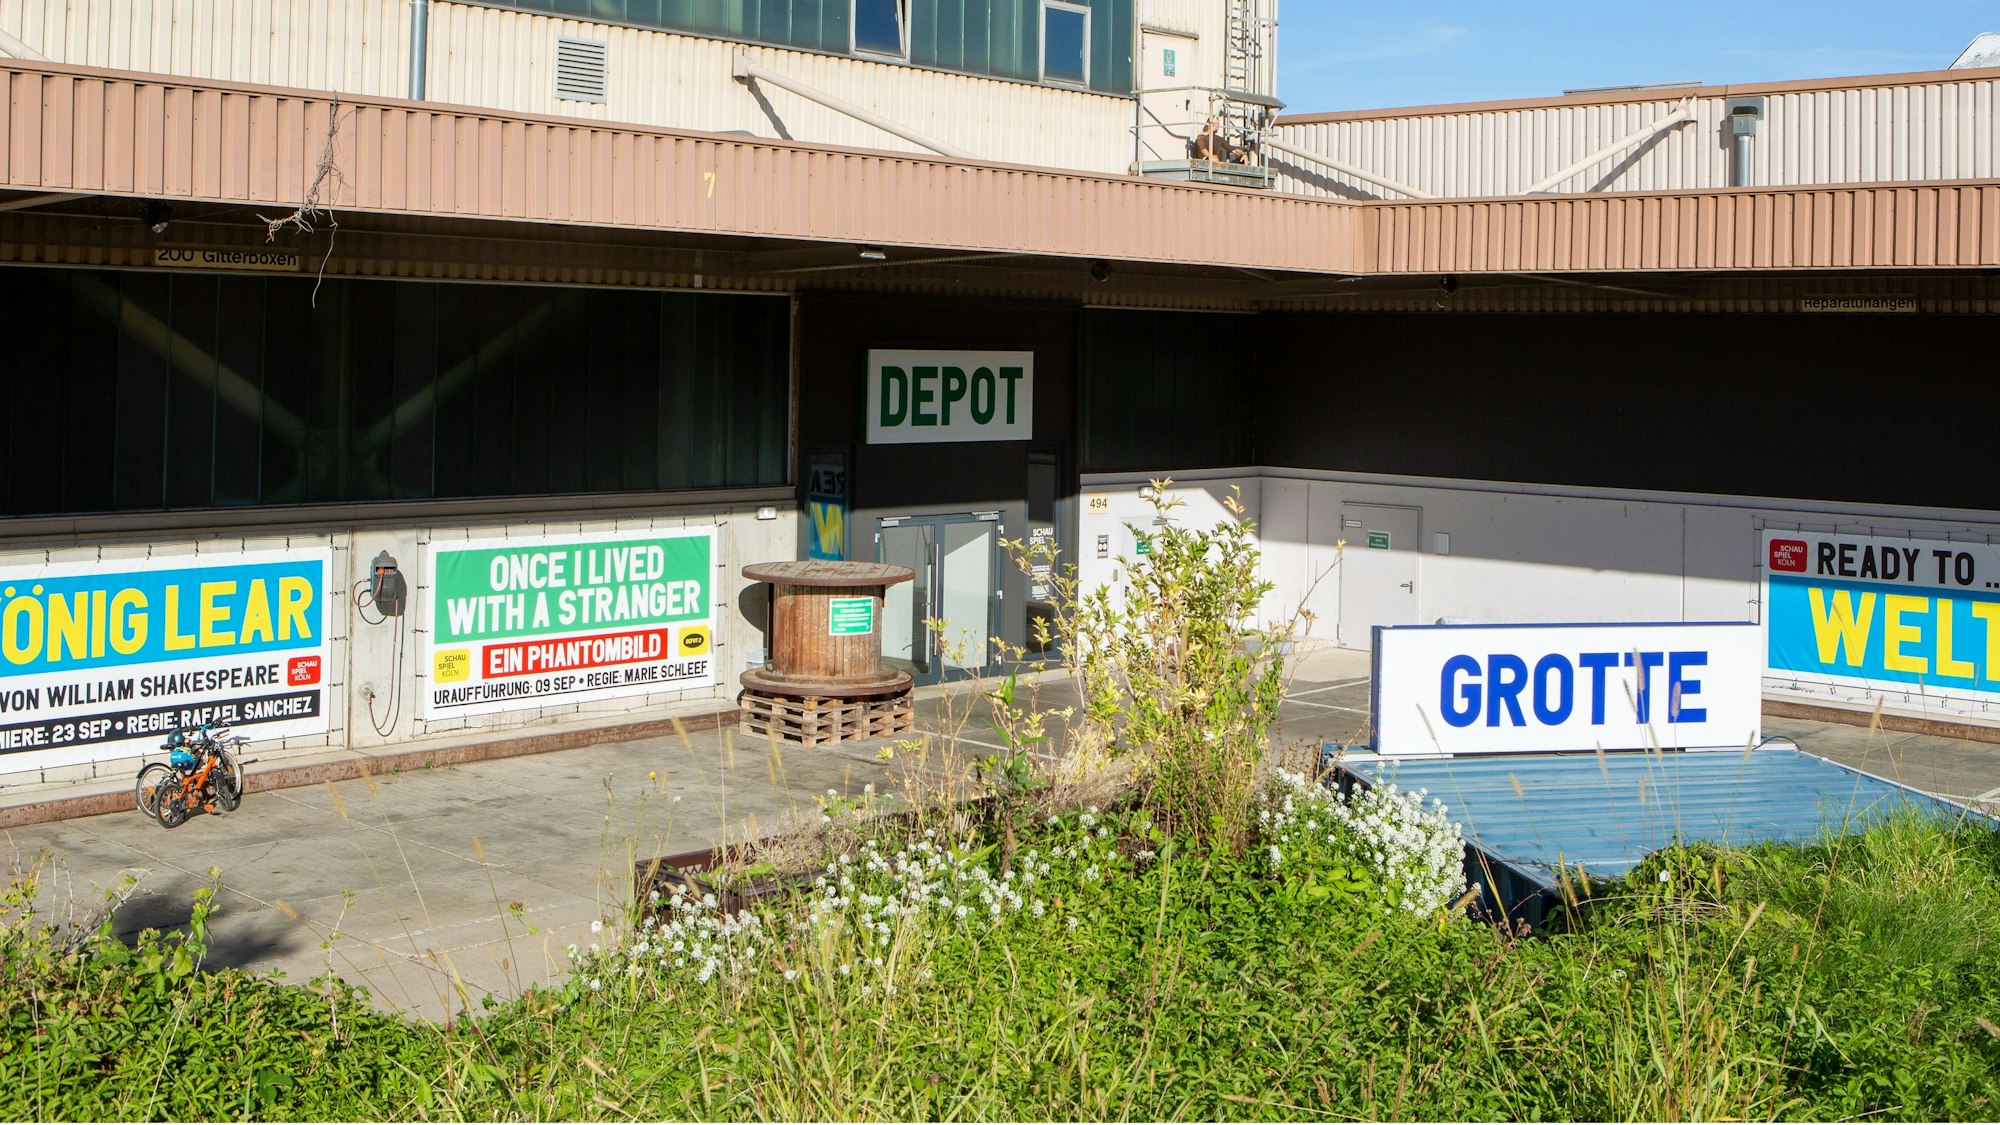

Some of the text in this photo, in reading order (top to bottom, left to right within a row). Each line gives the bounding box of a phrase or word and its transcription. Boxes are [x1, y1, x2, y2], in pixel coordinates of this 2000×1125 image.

[704, 172, 715, 198] 7
[158, 249, 297, 266] 200 Gitterboxen
[880, 366, 1023, 427] DEPOT
[1090, 498, 1107, 509] 494
[1029, 536, 1045, 545] SPIEL
[1033, 527, 1054, 537] SCHAU
[1774, 551, 1792, 559] SPIEL
[1780, 545, 1803, 553] SCHAU
[490, 545, 664, 591] ONCE I LIVED
[1777, 558, 1796, 567] KÖLN
[1817, 541, 1920, 582] READY
[1932, 550, 1975, 586] TO
[447, 579, 701, 636] WITH A STRANGER
[0, 576, 313, 665] ÖNIG LEAR
[1807, 587, 2000, 682] WELT
[444, 654, 466, 662] SCHAU
[490, 633, 661, 675] EIN PHANTOMBILD
[291, 667, 307, 675] SPIEL
[438, 662, 455, 670] SPIEL
[442, 669, 459, 677] KÖLN
[294, 673, 311, 681] KÖLN
[434, 660, 708, 705] URAUFFÜHRUNG: 09 SEP REGIE: MARIE SCHLEEF
[0, 664, 279, 713] VON WILLIAM SHAKESPEARE
[1440, 651, 1708, 728] GROTTE
[52, 723, 75, 744] 23
[79, 719, 111, 740] SEP
[127, 711, 178, 734] REGIE:
[181, 704, 241, 728] RAFAEL
[244, 696, 312, 720] SANCHEZ
